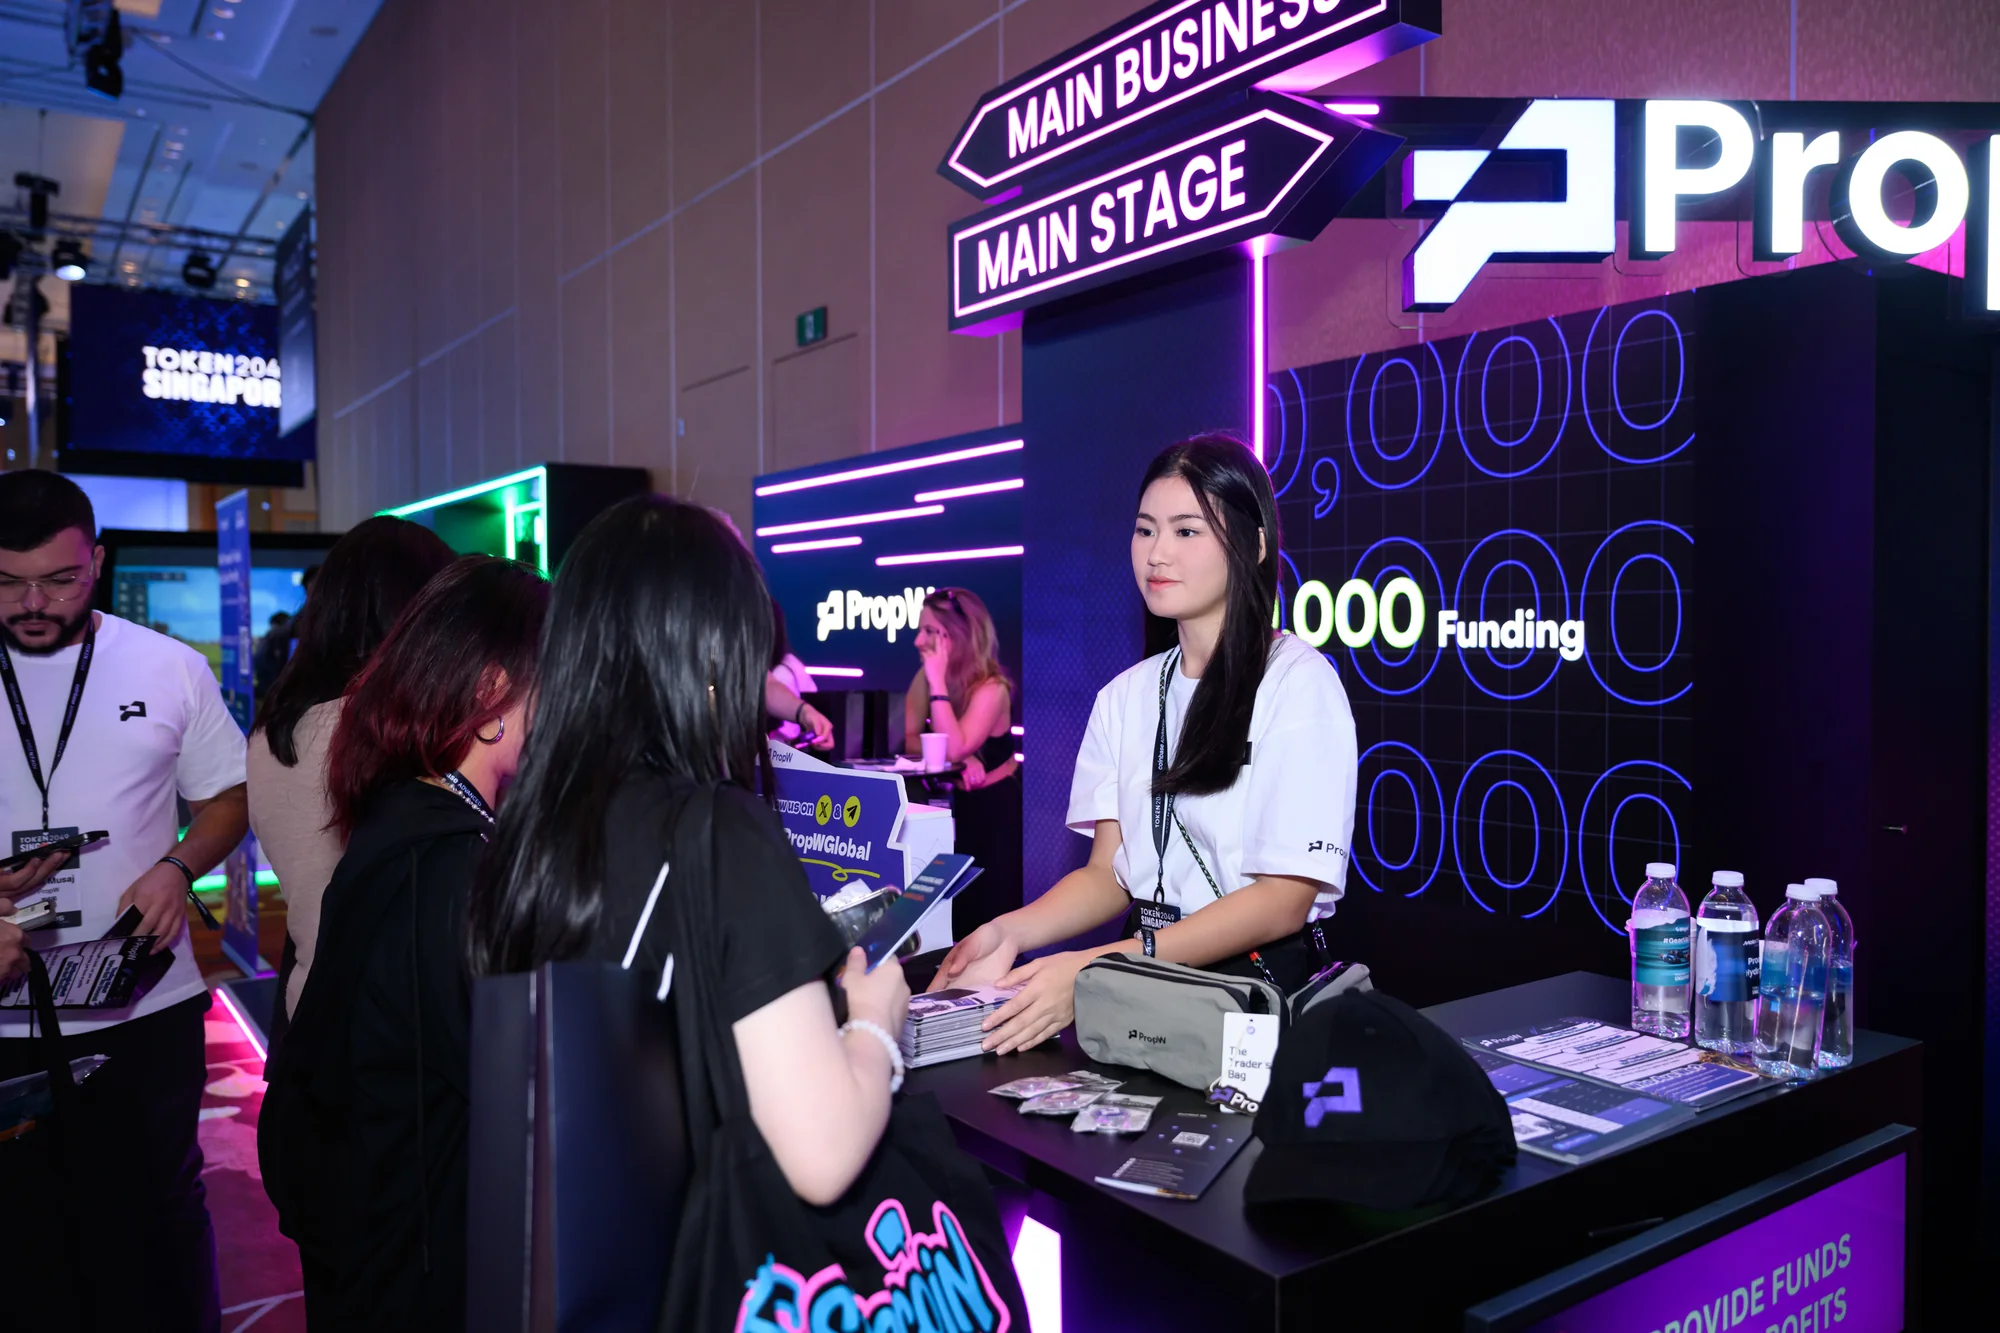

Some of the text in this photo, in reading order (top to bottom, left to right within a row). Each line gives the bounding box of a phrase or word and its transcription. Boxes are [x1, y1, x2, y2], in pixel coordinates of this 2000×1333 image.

[1007, 64, 1103, 159] MAIN
[977, 139, 1246, 294] MAIN STAGE
[1644, 98, 2000, 312] Pro
[142, 345, 281, 379] TOKEN204
[142, 368, 282, 408] SINGAPOR
[1438, 608, 1586, 662] Funding
[772, 750, 794, 763] PropW
[457, 782, 482, 807] ADVANCED
[1154, 795, 1162, 828] TOKEN20
[1140, 907, 1175, 921] TOKEN2049
[1141, 915, 1175, 929] SINGAPO
[1138, 1032, 1167, 1045] PropW
[1228, 1069, 1247, 1081] Bag
[1230, 1092, 1259, 1112] Pro
[1771, 1232, 1852, 1305] FUNDS
